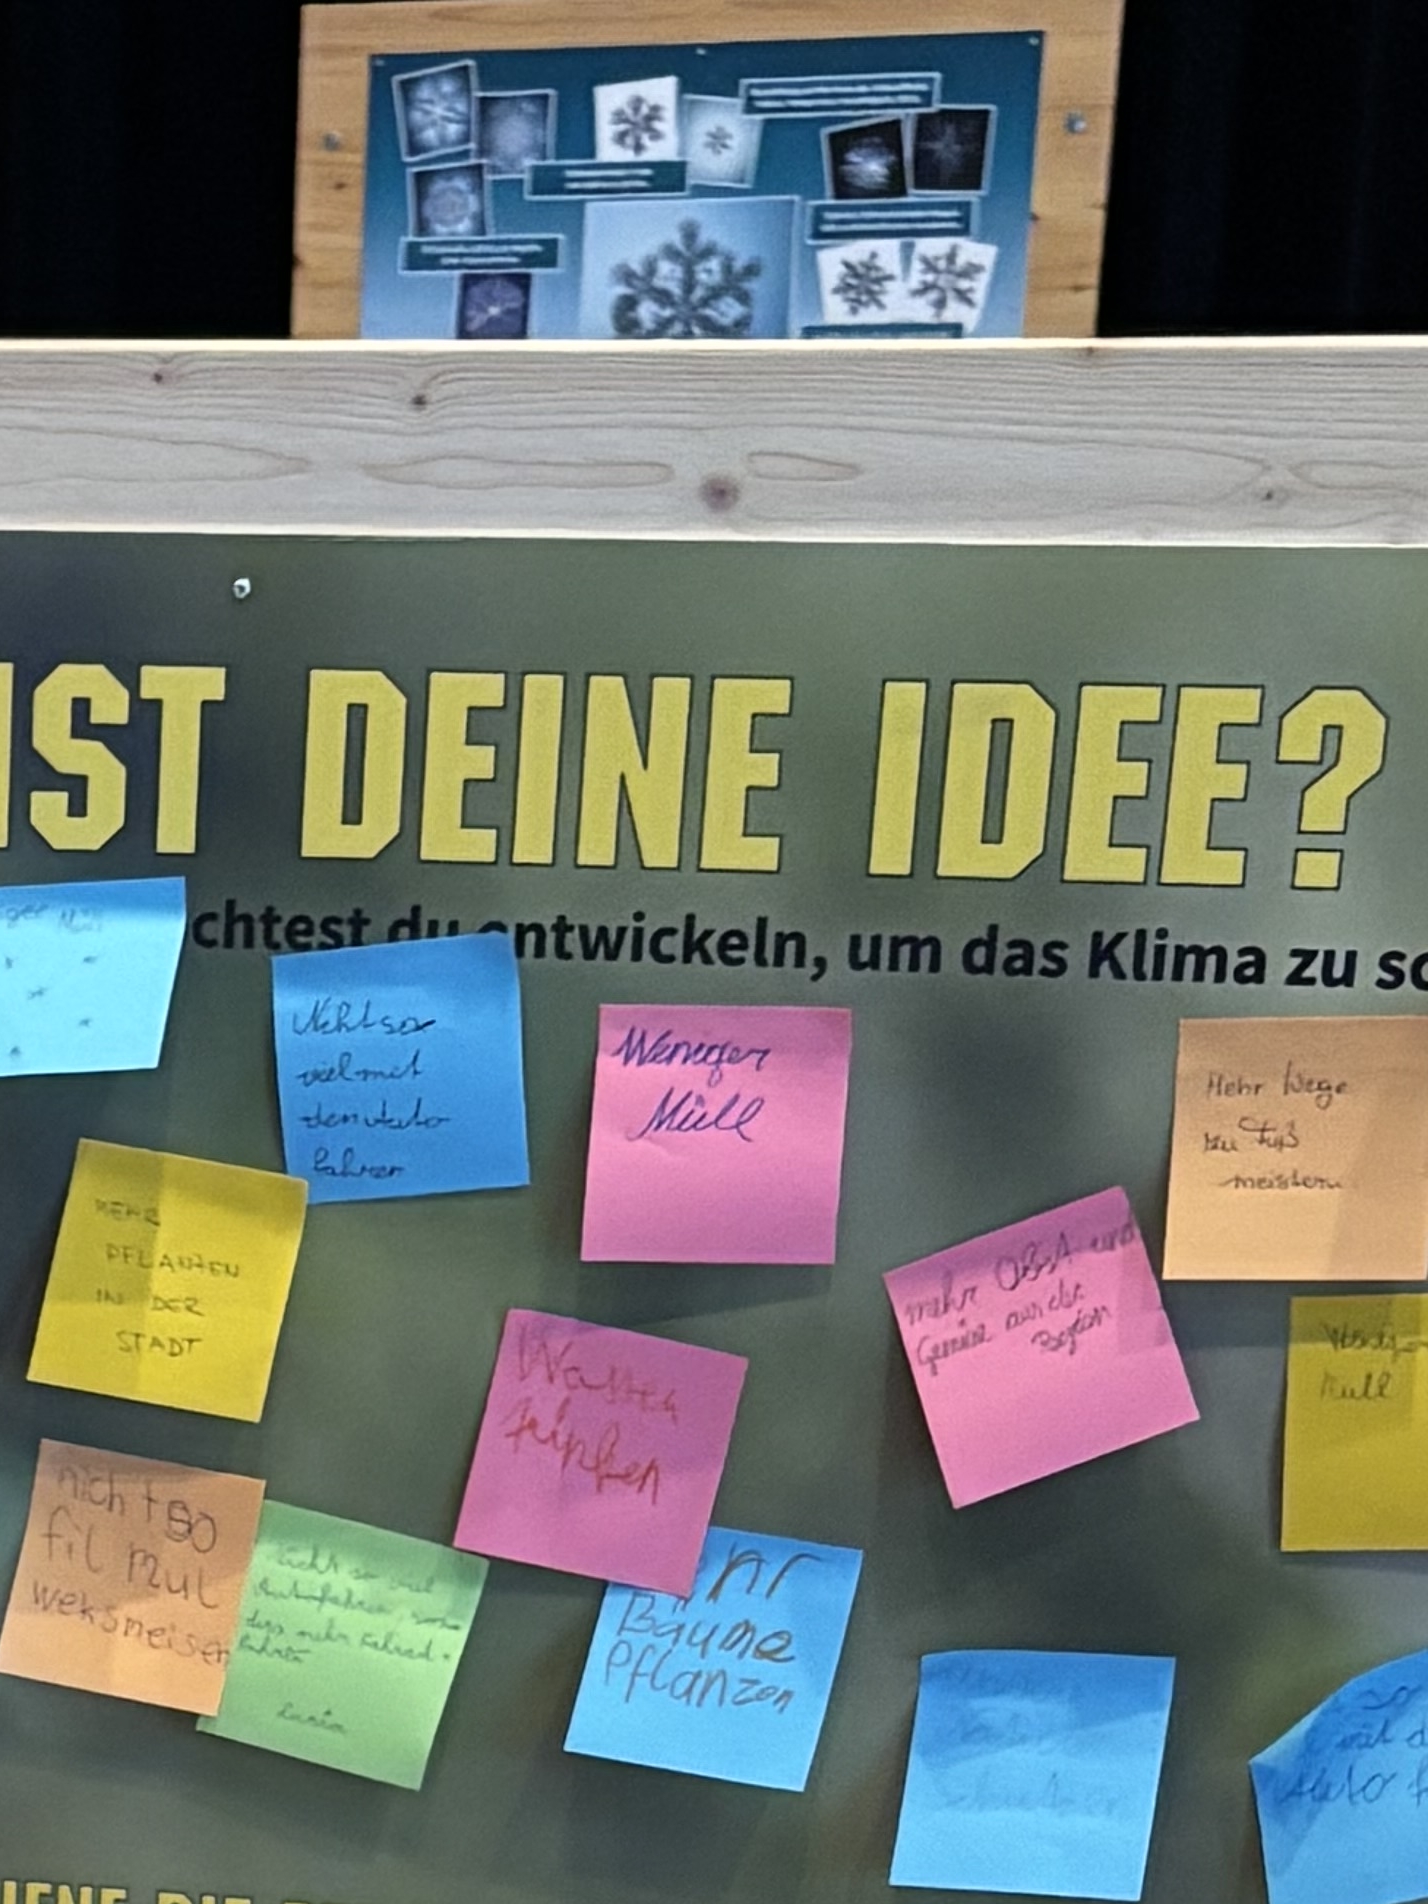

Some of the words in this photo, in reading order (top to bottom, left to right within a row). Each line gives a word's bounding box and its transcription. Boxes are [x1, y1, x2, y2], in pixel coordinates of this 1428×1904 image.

[299, 667, 795, 875] DEINE
[865, 678, 1390, 892] IDEE?
[191, 898, 371, 952] chtest
[469, 912, 830, 984] ntwickeln,
[847, 930, 942, 975] um
[961, 924, 1070, 979] das
[1087, 927, 1268, 986] Klima
[1284, 945, 1359, 989] zu
[114, 1329, 204, 1358] STADT
